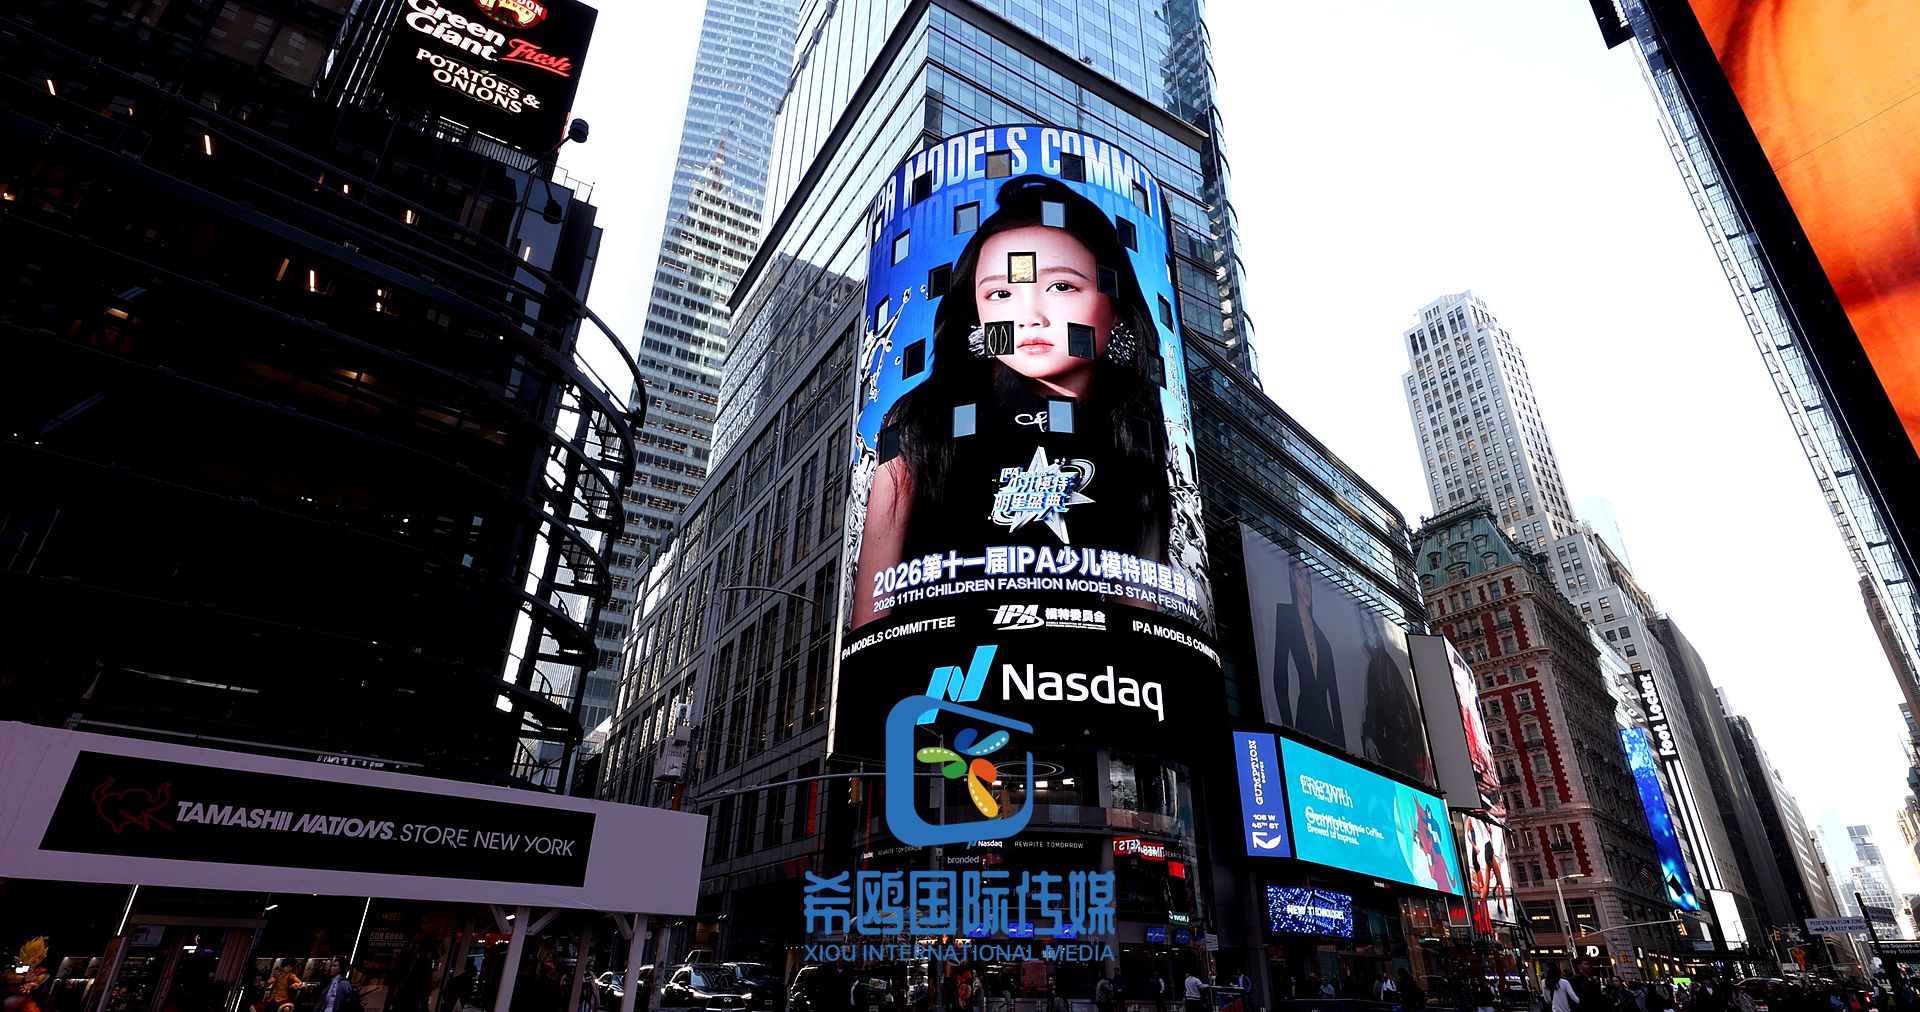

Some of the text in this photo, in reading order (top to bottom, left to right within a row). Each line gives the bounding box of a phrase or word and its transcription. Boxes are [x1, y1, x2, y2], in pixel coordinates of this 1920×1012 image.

[405, 12, 573, 71] Giant Fresh
[408, 0, 506, 47] Green
[416, 48, 540, 109] POTATOES &
[433, 69, 522, 114] ONIONS
[872, 545, 1199, 605] 2026第十一届IPA少儿模特明星盛典
[873, 577, 1199, 620] 2026 11TH CHILDREN FASHION MODELS STAR FESTIVAL
[992, 604, 1041, 626] IPA
[851, 631, 884, 654] MODELS
[884, 616, 956, 640] COMMITTEE
[1132, 620, 1152, 634] IPA
[1153, 625, 1192, 646] MODELS
[1002, 663, 1165, 722] Nasdaq
[1639, 673, 1676, 756] Foot Locker
[1248, 739, 1264, 806] GUMPTION
[176, 801, 293, 831] TAMASHII
[400, 823, 469, 849] STORE
[474, 830, 520, 851] NEW
[524, 834, 575, 857] YORK
[978, 840, 1003, 849] Nasdaq
[947, 856, 980, 864] branded
[1286, 904, 1307, 915] NEW
